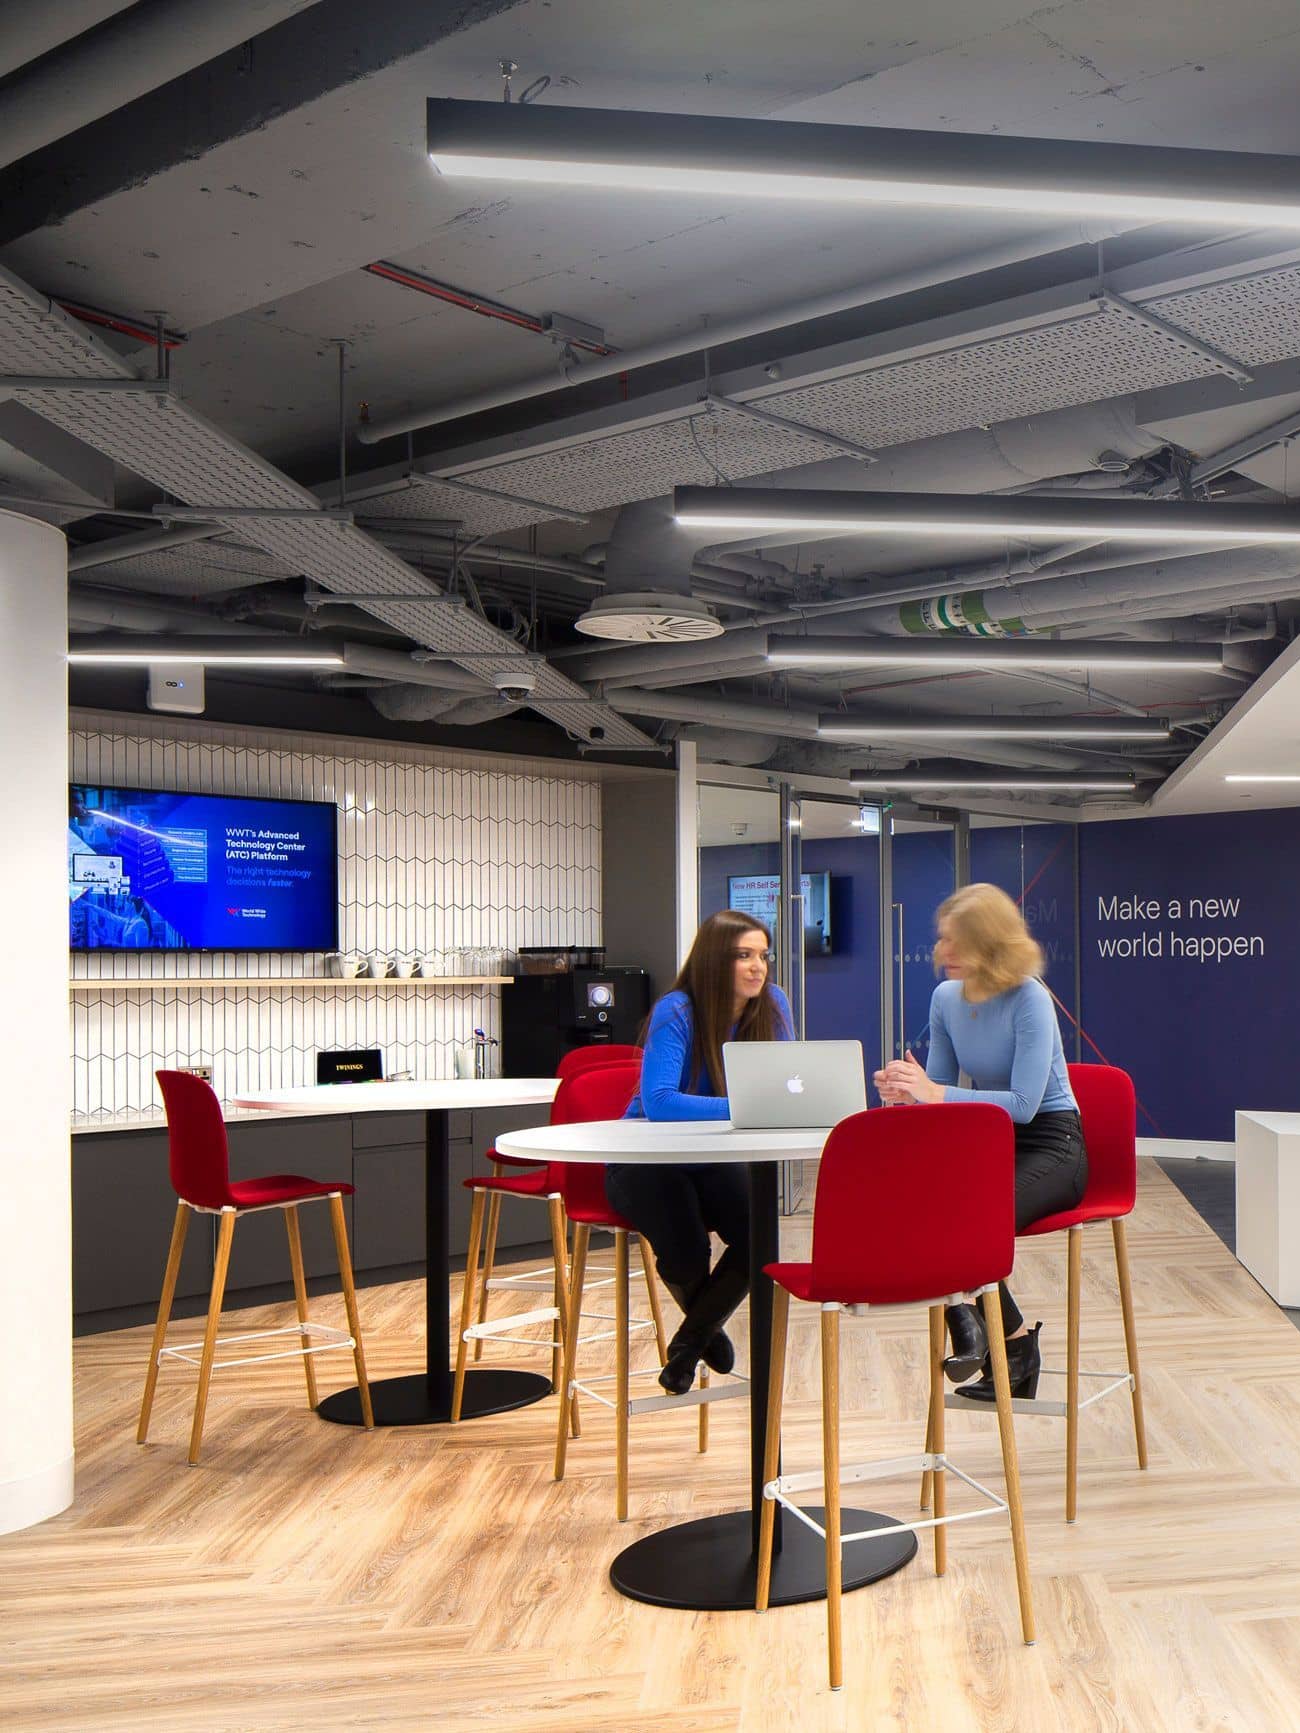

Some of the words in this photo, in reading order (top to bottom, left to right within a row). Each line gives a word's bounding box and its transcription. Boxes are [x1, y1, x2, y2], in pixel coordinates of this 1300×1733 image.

[225, 828, 256, 837] WWT's
[257, 830, 300, 840] Advanced
[225, 839, 276, 851] Technology
[276, 842, 306, 851] Center
[225, 850, 250, 860] (ATC)
[251, 851, 288, 861] Platform
[226, 866, 242, 874] The
[243, 866, 264, 877] right
[265, 868, 311, 880] technology
[226, 877, 266, 887] decisions
[1098, 894, 1161, 921] Make
[1167, 899, 1181, 919] a
[1189, 897, 1241, 919] new
[1097, 931, 1162, 958] world
[1171, 931, 1264, 963] happen
